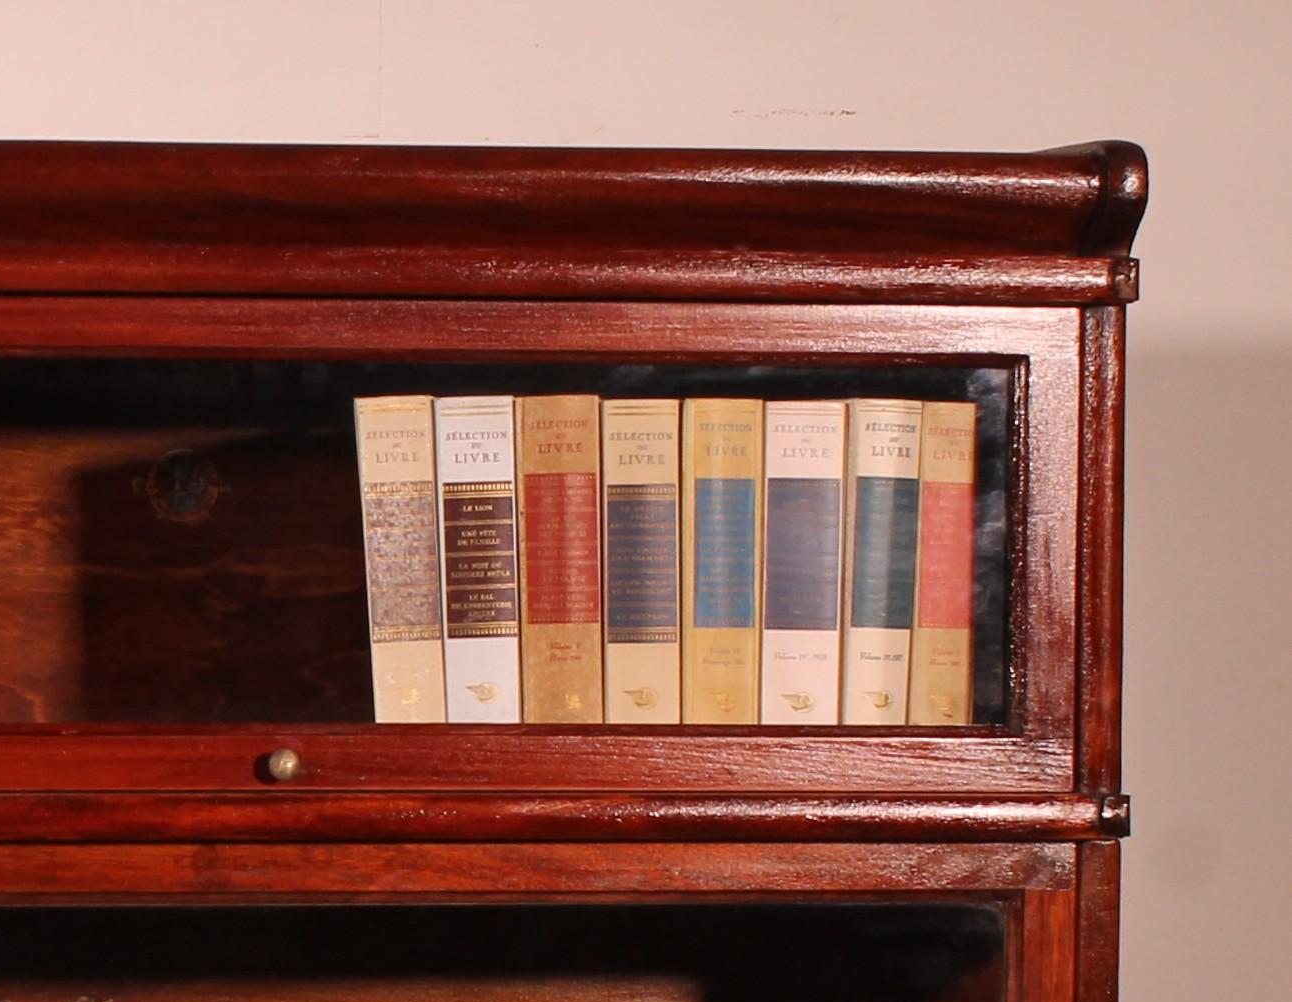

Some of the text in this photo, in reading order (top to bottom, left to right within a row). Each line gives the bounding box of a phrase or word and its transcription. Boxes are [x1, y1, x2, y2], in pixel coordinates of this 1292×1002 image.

[445, 430, 508, 441] SÉLECTION
[538, 442, 583, 455] LIVRE
[782, 448, 830, 459] LIVRE
[872, 446, 911, 459] LIVRE
[454, 452, 501, 464] LIVRE
[619, 453, 665, 465] LIVRE
